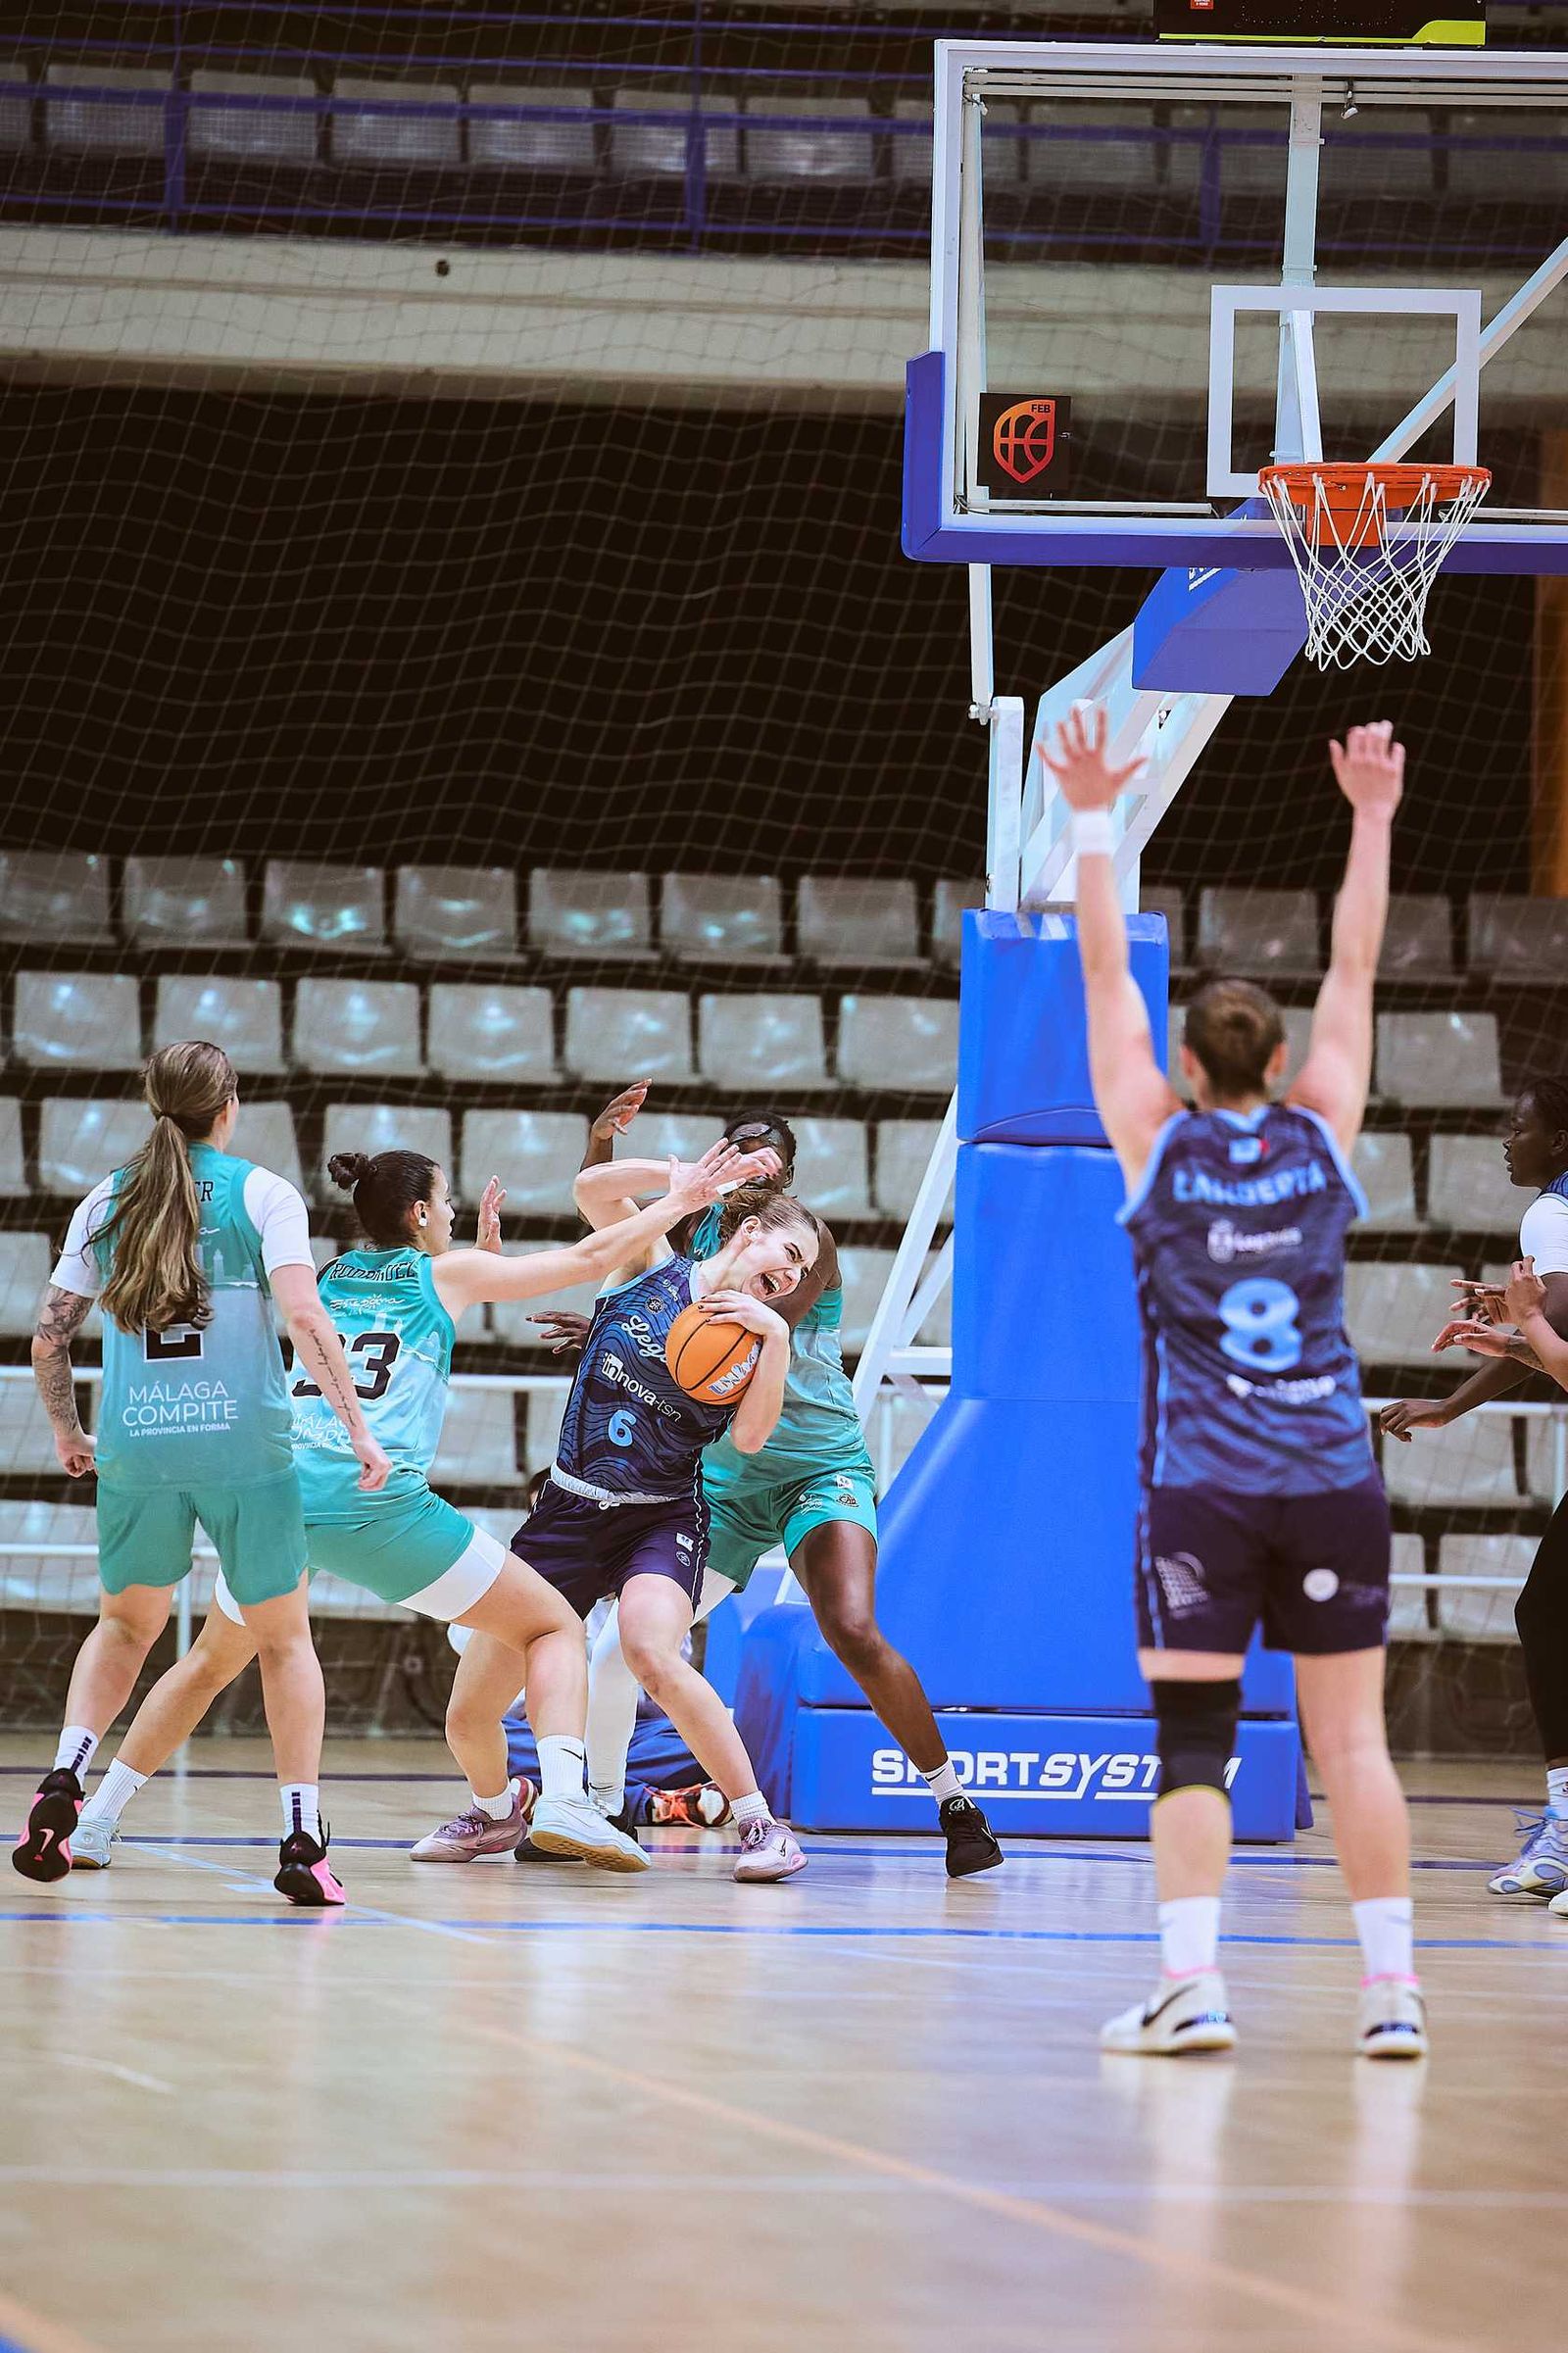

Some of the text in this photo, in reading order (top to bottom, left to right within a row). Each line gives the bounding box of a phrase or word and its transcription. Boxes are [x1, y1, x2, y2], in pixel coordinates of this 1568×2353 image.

[1031, 404, 1051, 413] FEB
[1218, 1277, 1301, 1371] 8
[128, 1379, 228, 1404] MÁLAGA
[122, 1399, 239, 1427] COMPITE
[129, 1422, 231, 1438] LA PROVINCIA EN FORMA
[608, 1409, 637, 1447] 6
[871, 1748, 1243, 1789] SORTSYST
